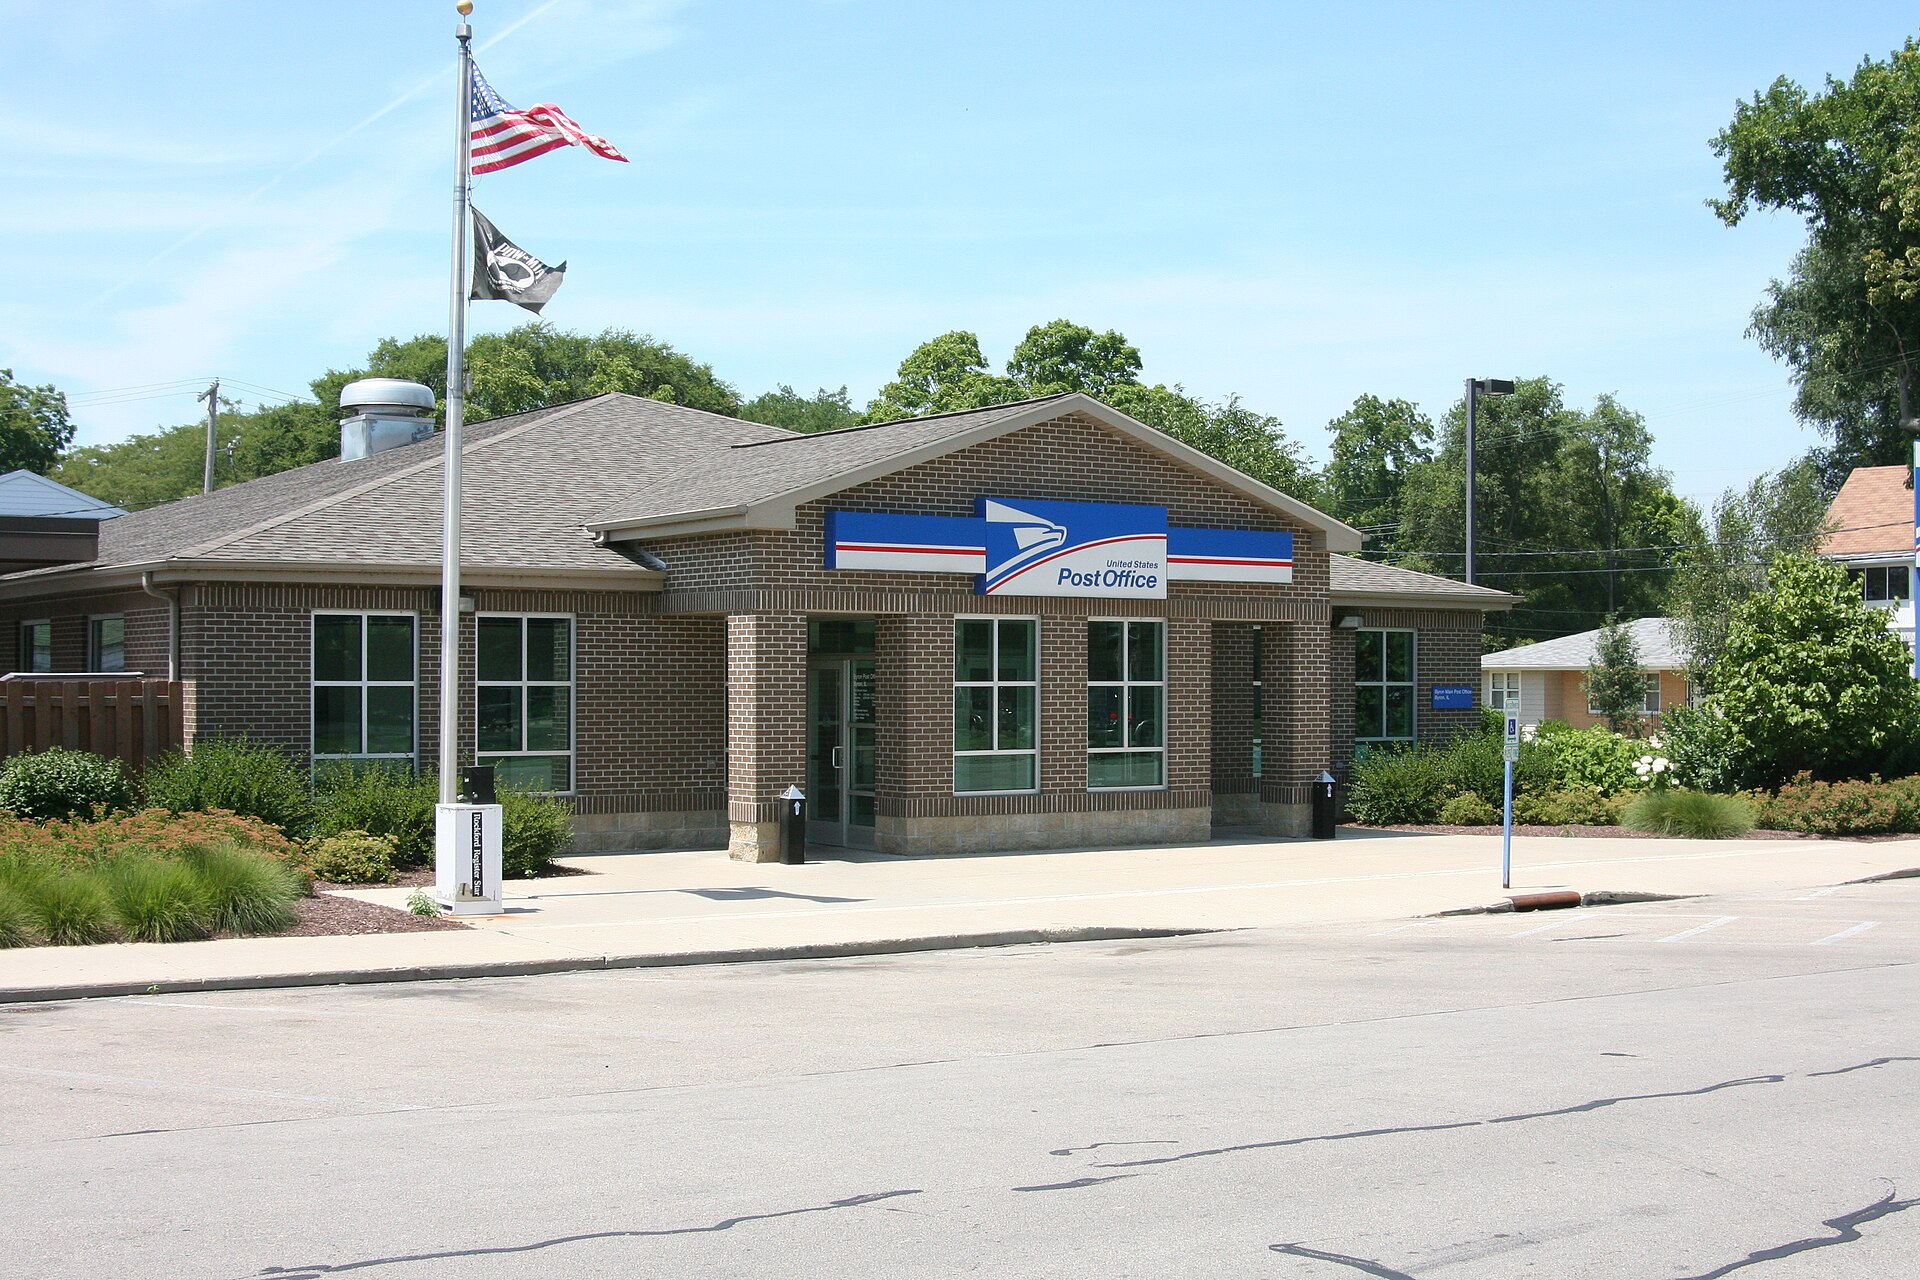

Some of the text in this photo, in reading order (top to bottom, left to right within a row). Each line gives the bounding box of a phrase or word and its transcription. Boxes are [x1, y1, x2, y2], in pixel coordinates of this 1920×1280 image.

[493, 242, 526, 261] POW
[1106, 559, 1159, 570] United States
[1057, 567, 1158, 589] Post Office
[472, 813, 482, 897] Rockford Register Star
